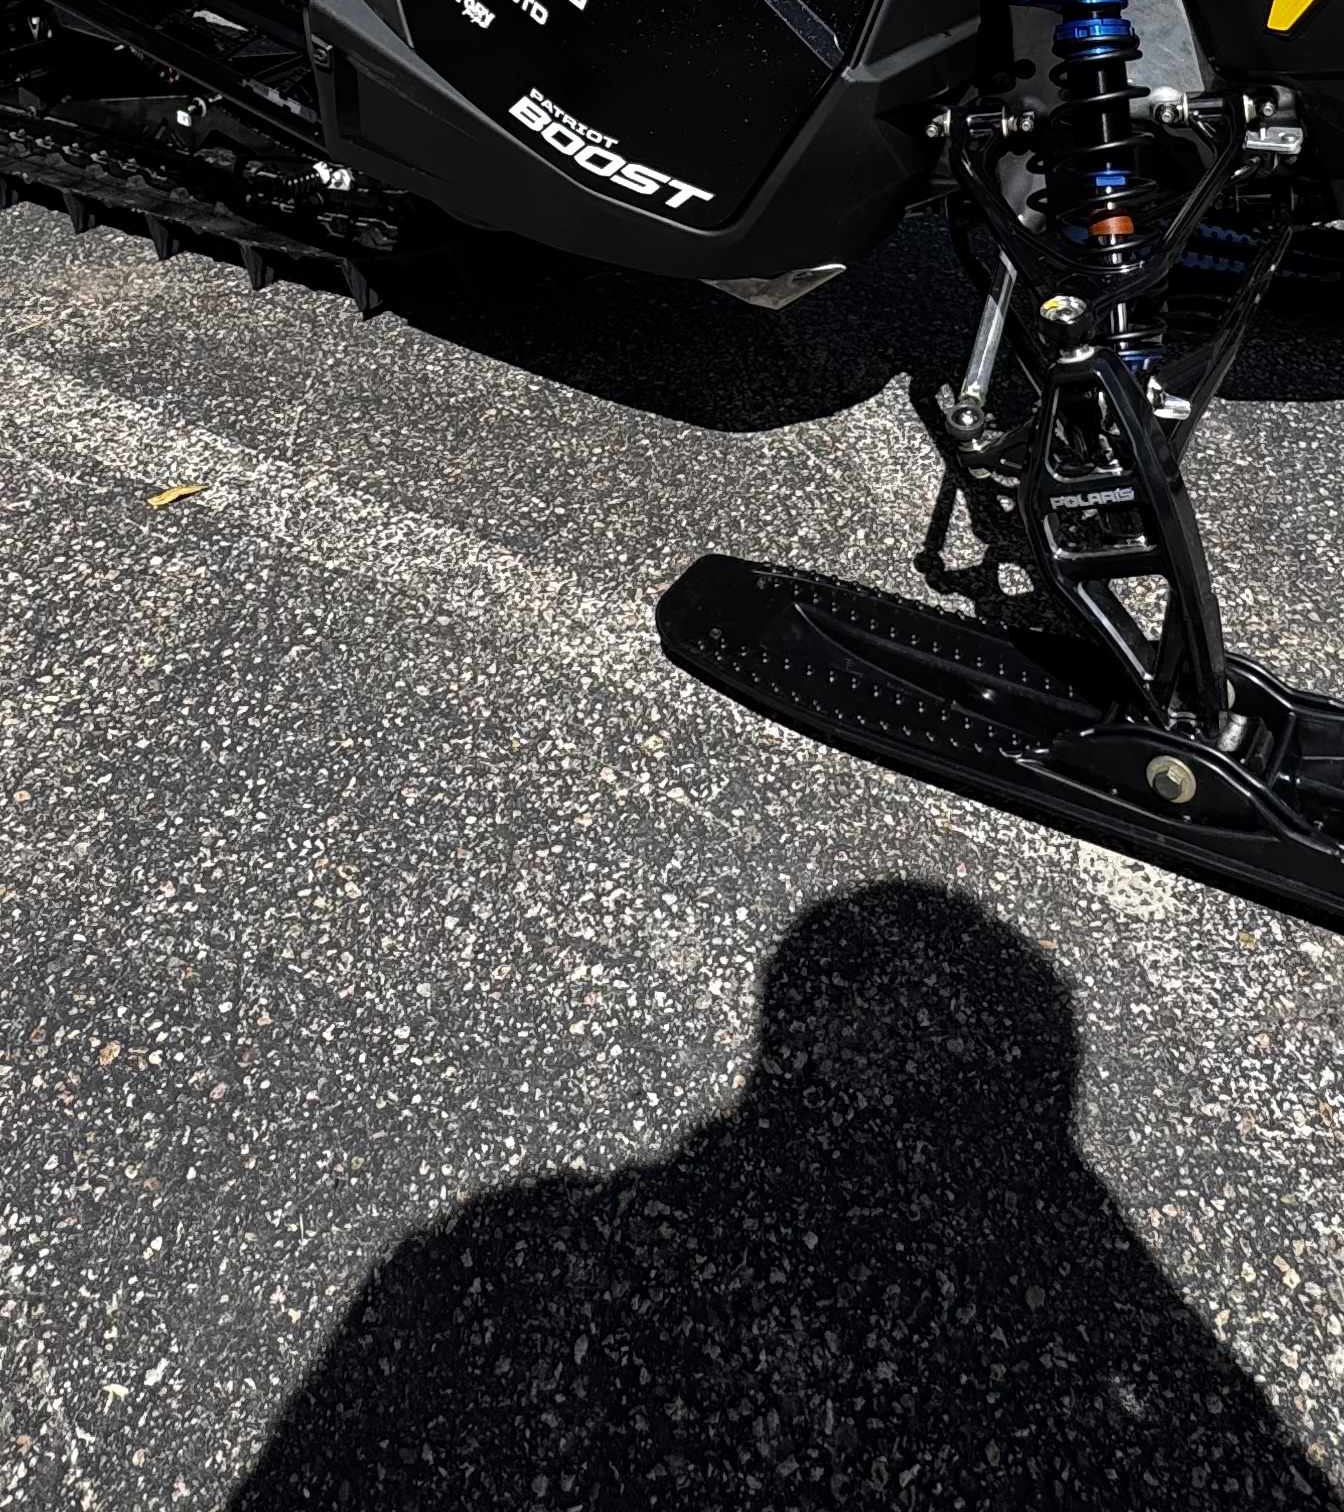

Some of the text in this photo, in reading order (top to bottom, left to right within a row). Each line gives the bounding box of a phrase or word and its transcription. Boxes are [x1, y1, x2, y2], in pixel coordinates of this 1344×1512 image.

[528, 87, 620, 149] PATRIOT
[507, 95, 716, 210] BOOST
[1049, 486, 1136, 511] POLARIS
